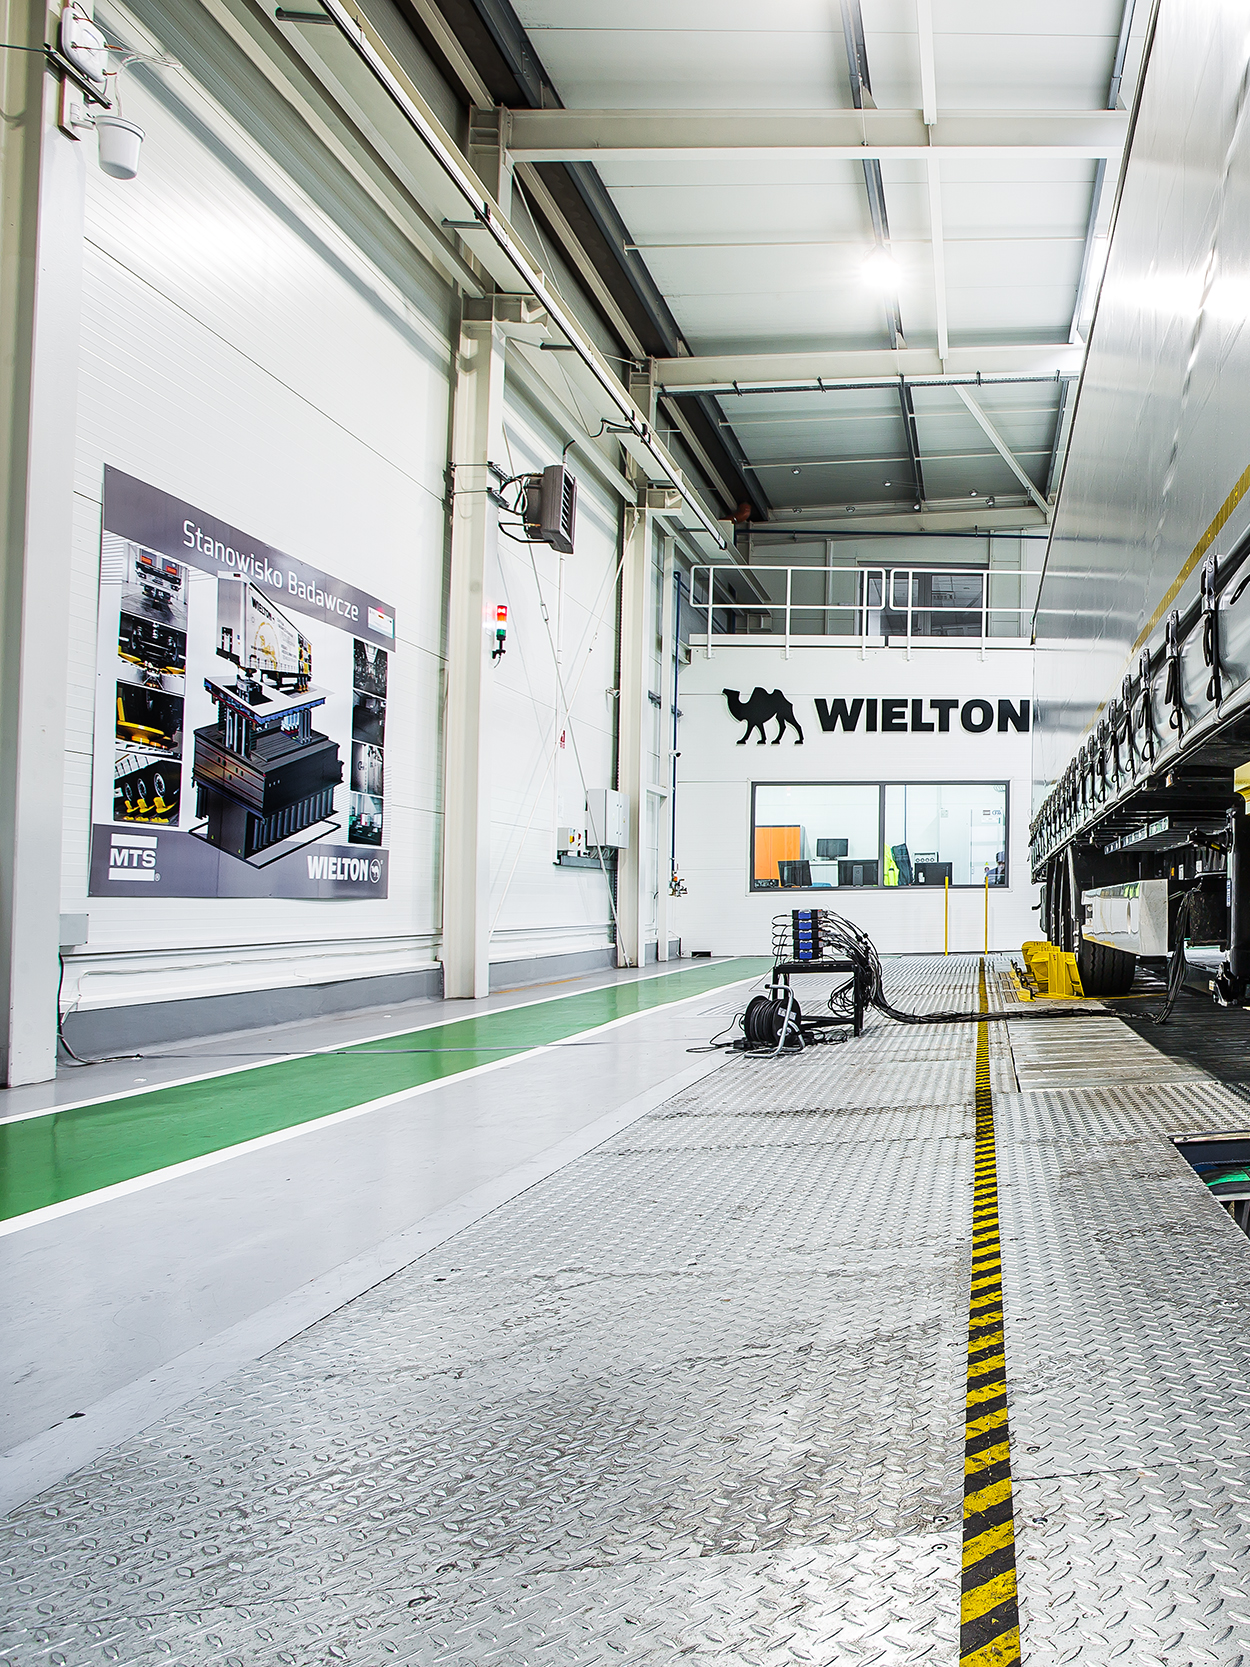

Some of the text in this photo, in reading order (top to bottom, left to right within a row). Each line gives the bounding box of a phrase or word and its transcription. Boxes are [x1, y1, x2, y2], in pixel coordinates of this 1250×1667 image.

[183, 519, 283, 589] Stanowisko
[287, 570, 359, 622] Badawcze
[814, 698, 1030, 733] WIELTON
[109, 848, 157, 868] MTS
[307, 855, 369, 881] WIELTON
